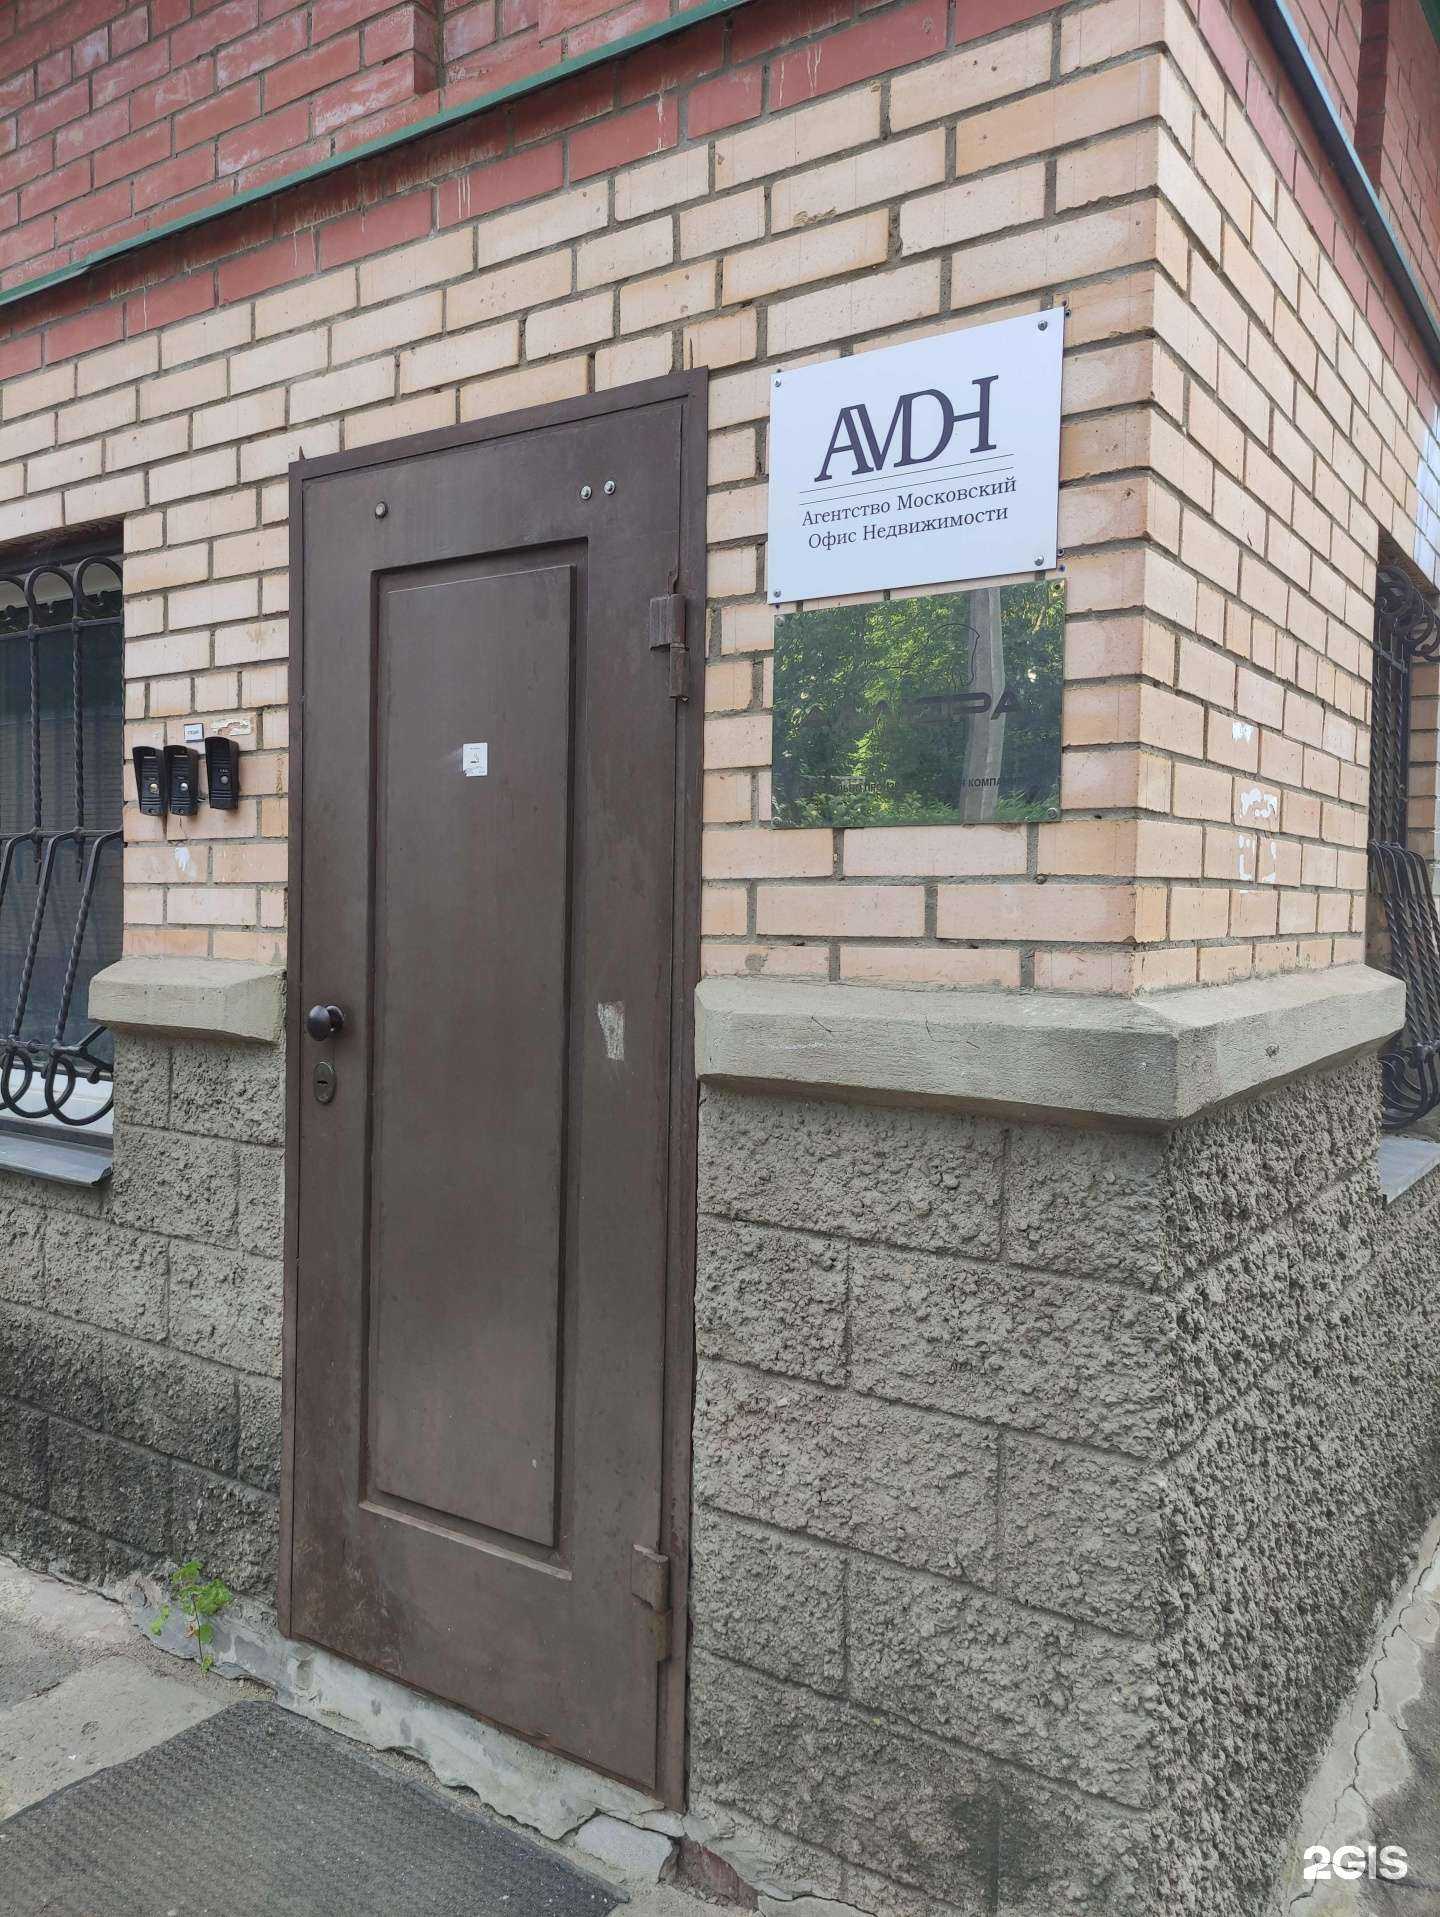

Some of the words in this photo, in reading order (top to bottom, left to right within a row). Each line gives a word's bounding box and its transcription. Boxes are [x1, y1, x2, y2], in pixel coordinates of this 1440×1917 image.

[801, 501, 891, 527] Агентство
[897, 475, 1017, 511] Московский
[808, 530, 857, 551] Офис
[863, 507, 1009, 542] Недвижимости
